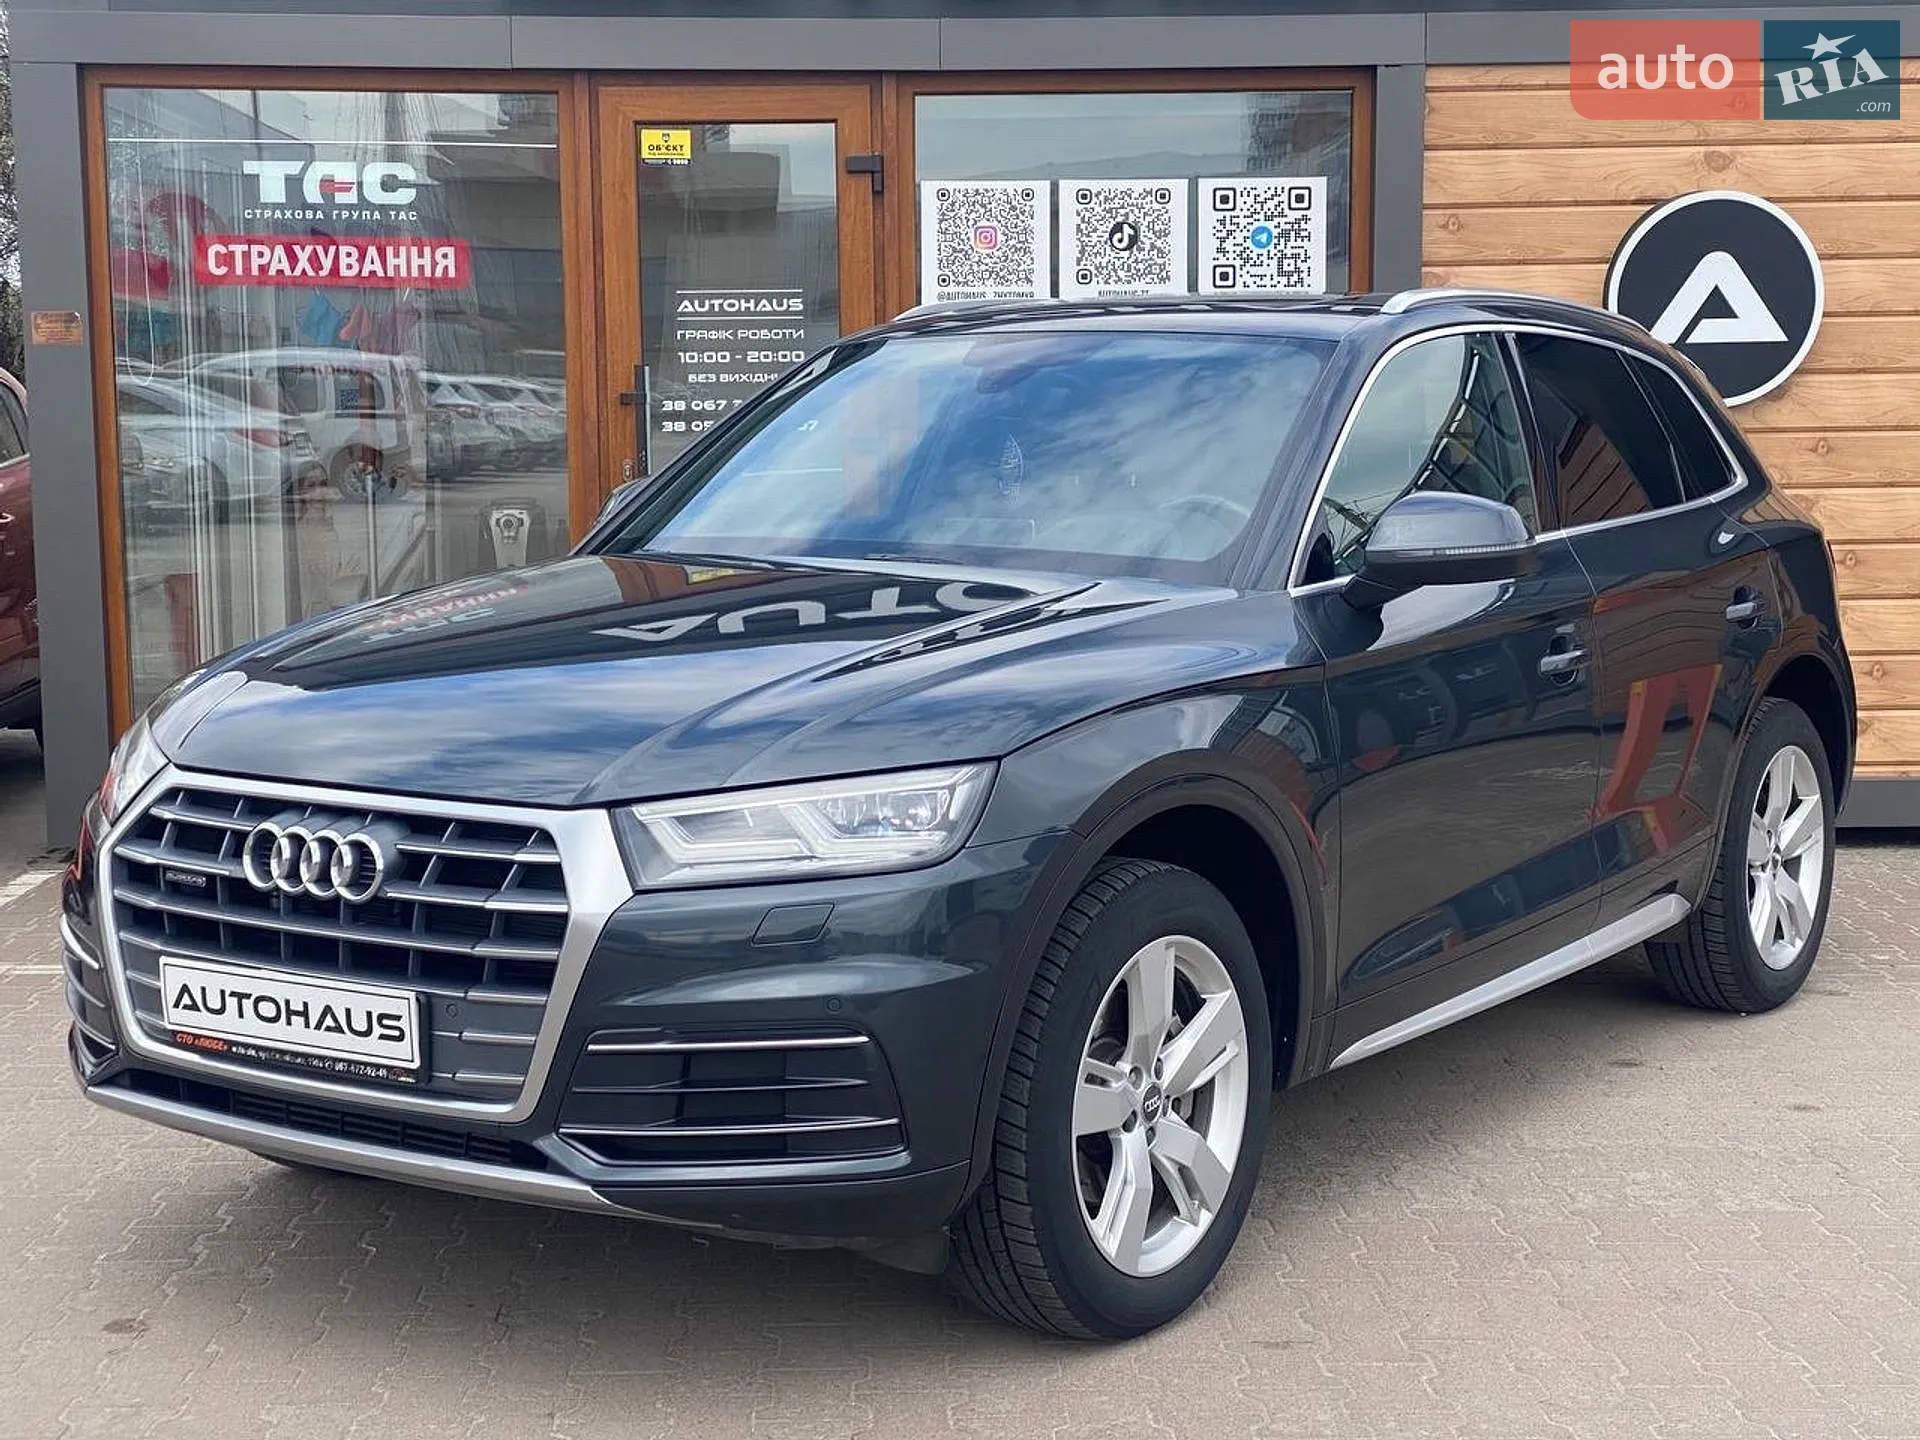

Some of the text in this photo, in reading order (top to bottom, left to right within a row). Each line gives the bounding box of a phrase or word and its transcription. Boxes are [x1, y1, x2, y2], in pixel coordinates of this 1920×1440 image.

[244, 209, 418, 221] СТРАХОВА ГРУПА ТАС
[207, 243, 456, 278] СТРАХУВАННЯ
[677, 299, 804, 312] AUTOHAUS
[677, 329, 804, 340] ГРАФІК РОБОТИ
[678, 351, 730, 364] 10:00
[747, 351, 805, 363] 20:00
[688, 373, 778, 384] БЕЗ ВИХІДН
[661, 400, 686, 411] 38
[691, 400, 727, 411] 067
[661, 421, 686, 432] 38
[172, 983, 406, 1043] AUTOHAUS
